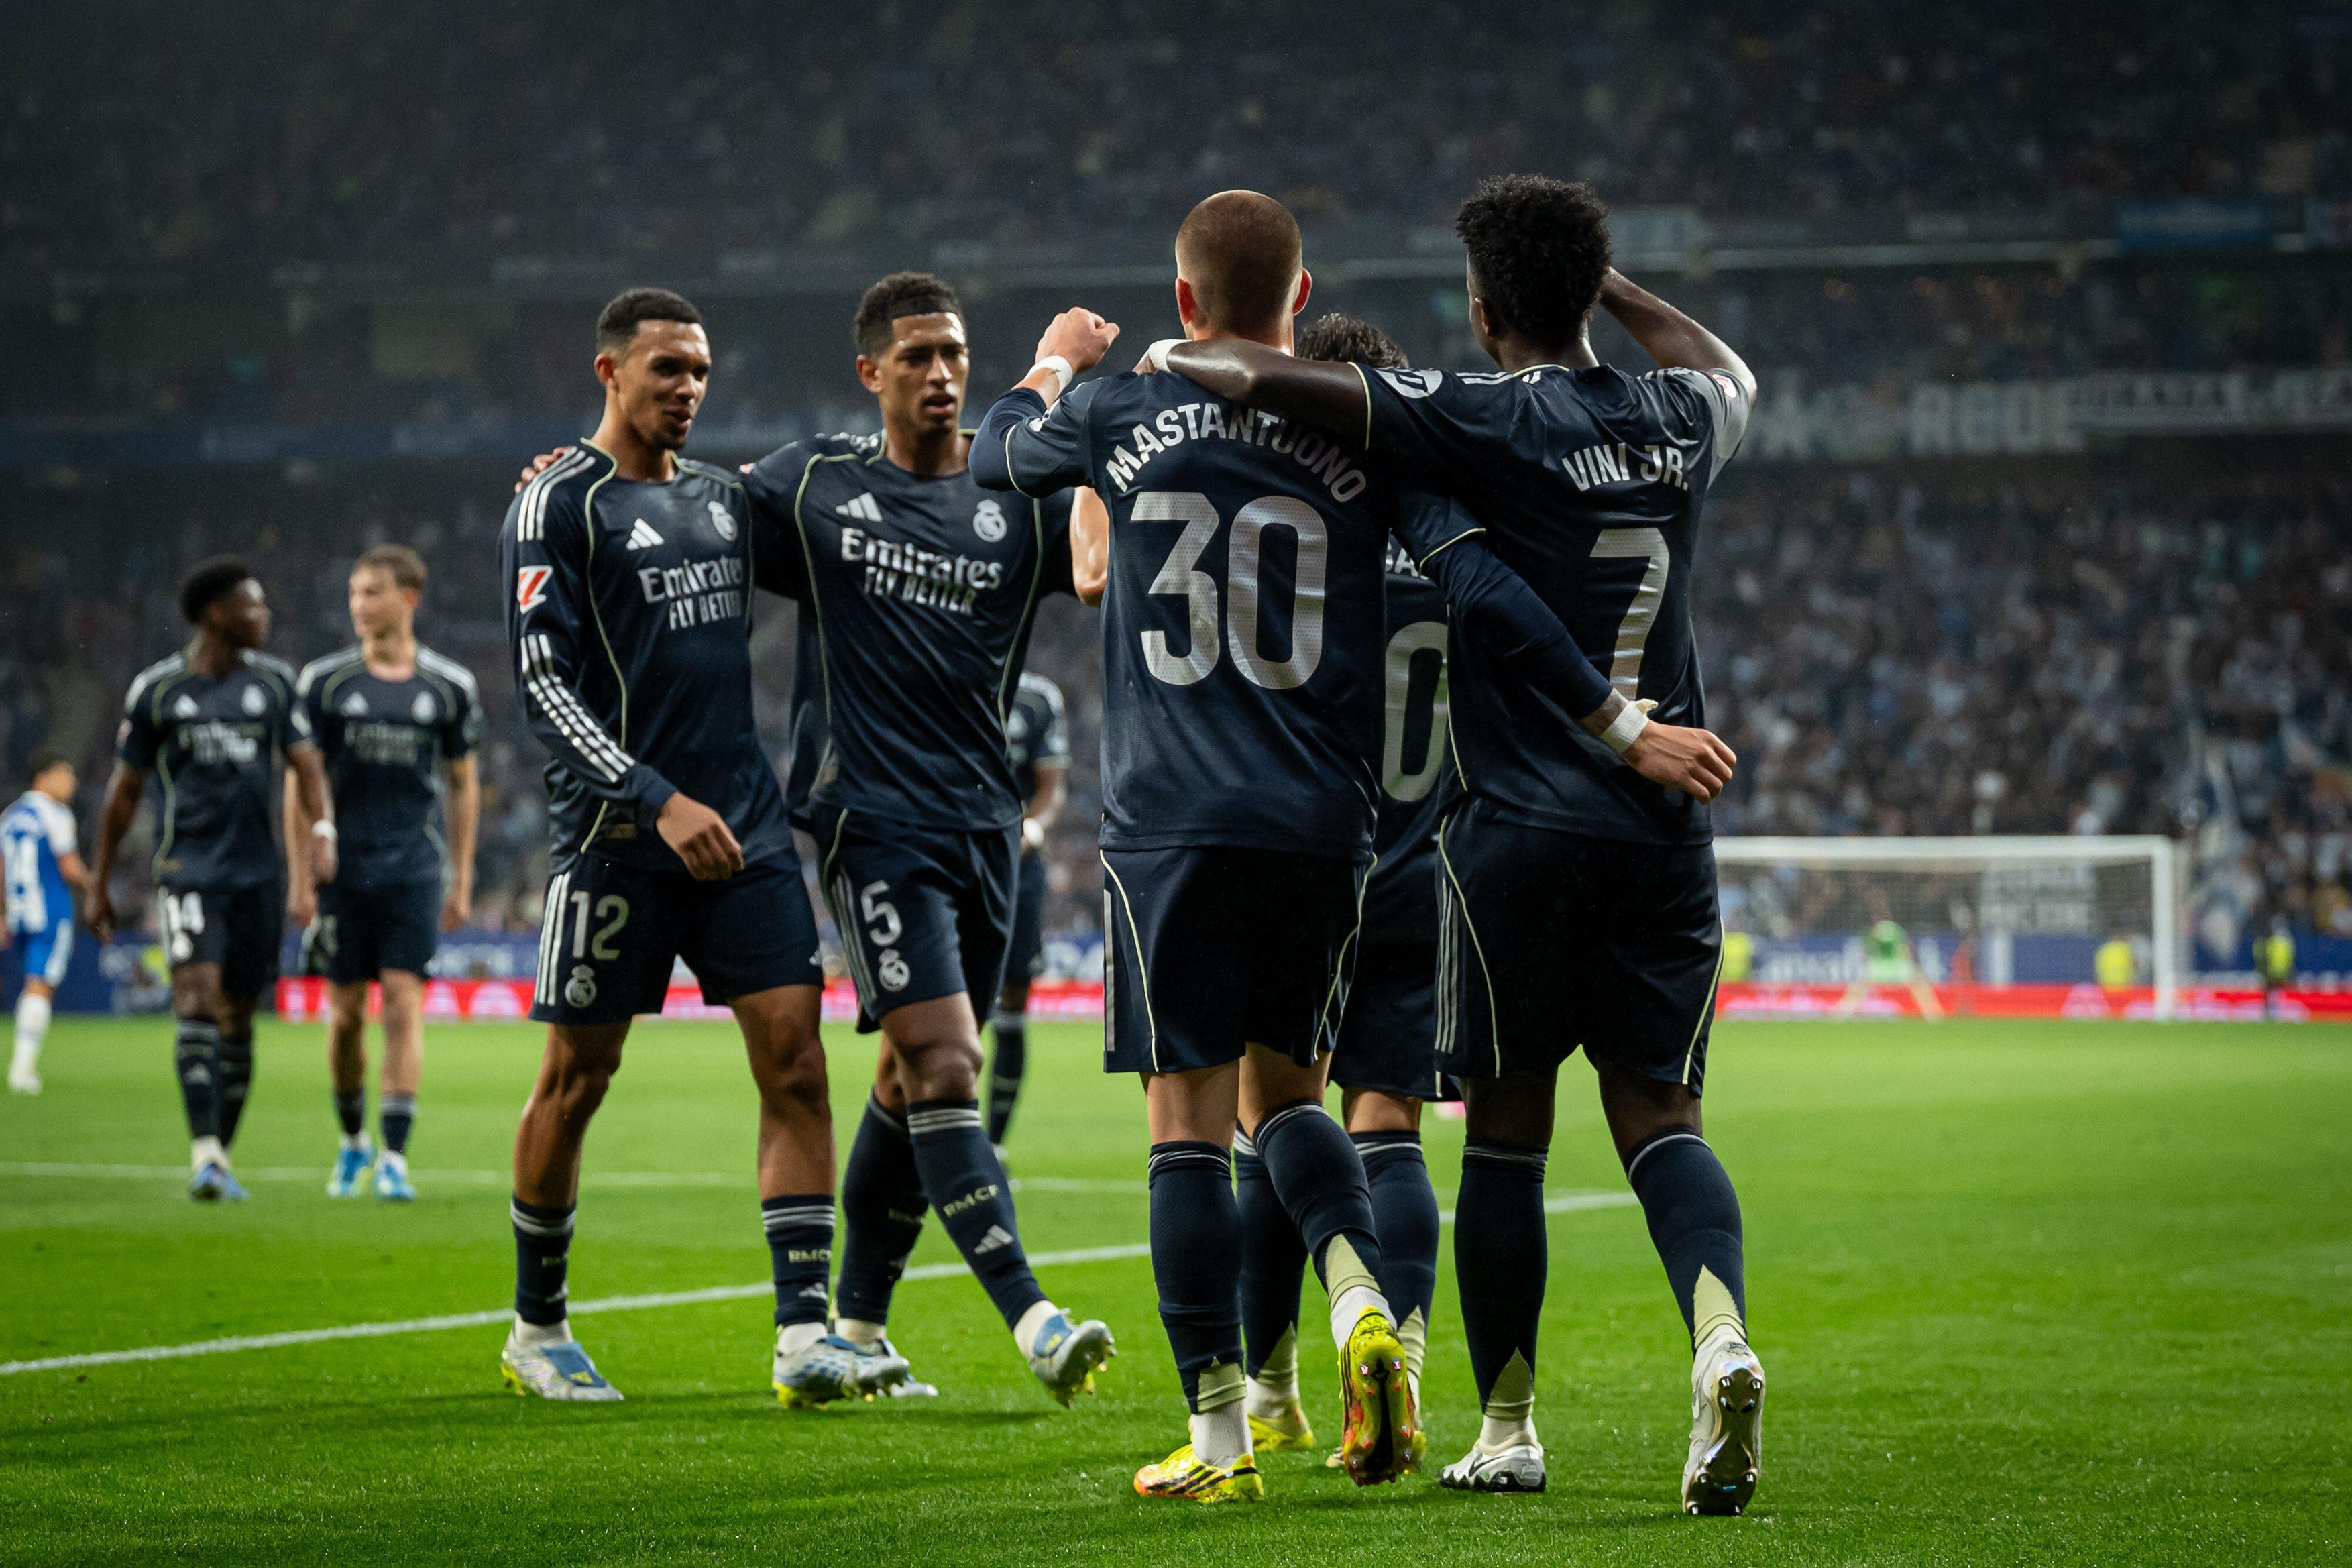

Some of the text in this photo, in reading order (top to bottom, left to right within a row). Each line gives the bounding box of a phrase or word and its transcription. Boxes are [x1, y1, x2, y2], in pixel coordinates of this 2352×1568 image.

[1105, 402, 1367, 502] MASTANTUONO
[1562, 442, 1688, 492] VINI JR.
[638, 554, 742, 604] Emirate
[841, 528, 1003, 590] Emirates
[864, 566, 899, 596] FLY
[1131, 491, 1328, 689] 30
[669, 598, 695, 630] FLY
[1589, 528, 1669, 700] 7
[570, 890, 629, 960] 12
[861, 879, 903, 946] 5
